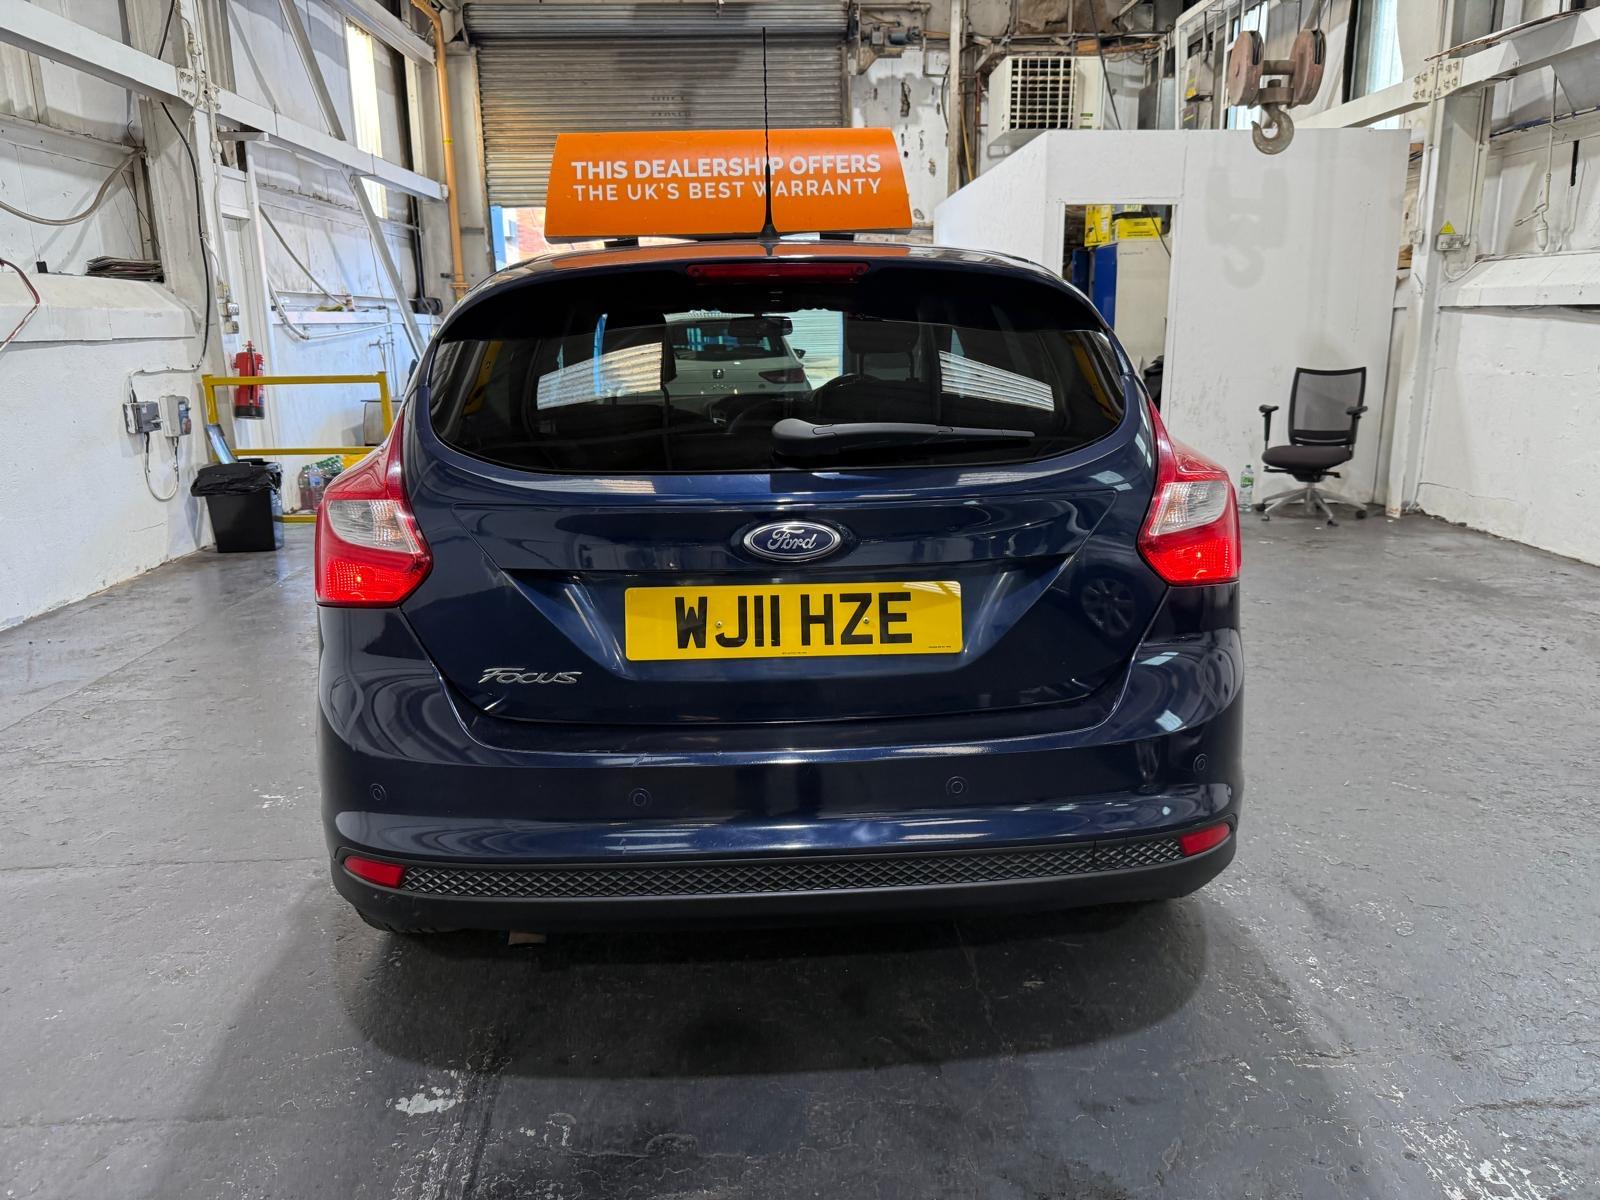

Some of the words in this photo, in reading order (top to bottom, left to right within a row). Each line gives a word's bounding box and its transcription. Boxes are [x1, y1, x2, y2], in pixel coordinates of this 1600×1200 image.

[571, 160, 628, 180] THIS
[634, 156, 784, 179] DEALERSHIP
[789, 153, 881, 175] OFFERS
[573, 184, 618, 201] THE
[627, 183, 680, 201] UK'S
[688, 181, 745, 199] BEST
[752, 177, 882, 198] WARRANTY
[767, 526, 818, 550] Ford
[675, 594, 780, 649] WJ11
[801, 591, 913, 646] HZE
